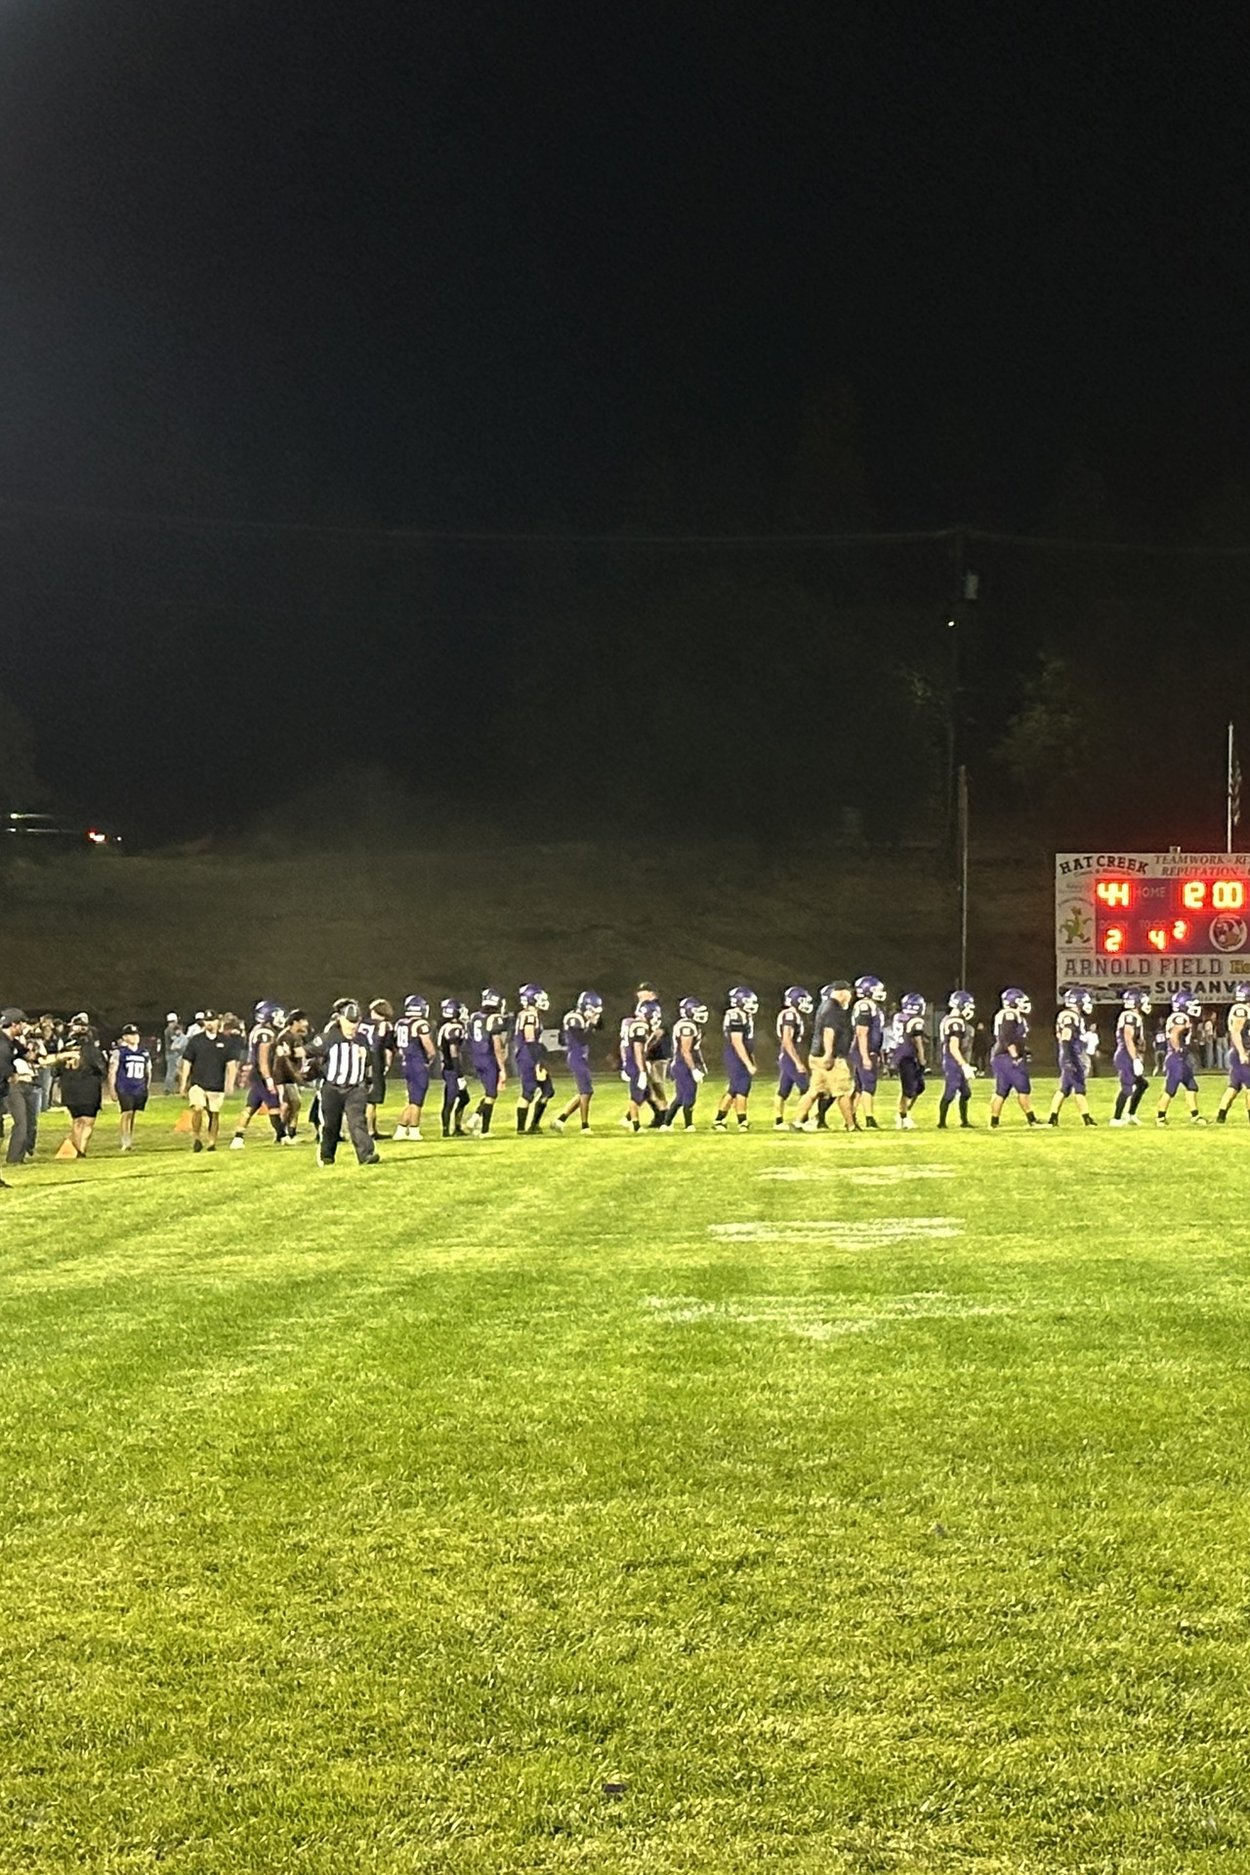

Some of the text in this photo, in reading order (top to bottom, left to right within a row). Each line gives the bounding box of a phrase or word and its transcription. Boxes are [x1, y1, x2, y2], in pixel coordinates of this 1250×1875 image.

[1059, 856, 1093, 874] HAT
[1096, 855, 1149, 874] CREEK
[1154, 855, 1224, 865] TEAMWORK
[1160, 866, 1239, 877] REPUTATION
[1097, 883, 1128, 906] 44
[1174, 920, 1186, 939] 2
[1106, 929, 1121, 951] 2
[1149, 930, 1165, 950] 4
[1064, 957, 1223, 977] ARNOLD FIELD
[125, 1062, 145, 1079] 10
